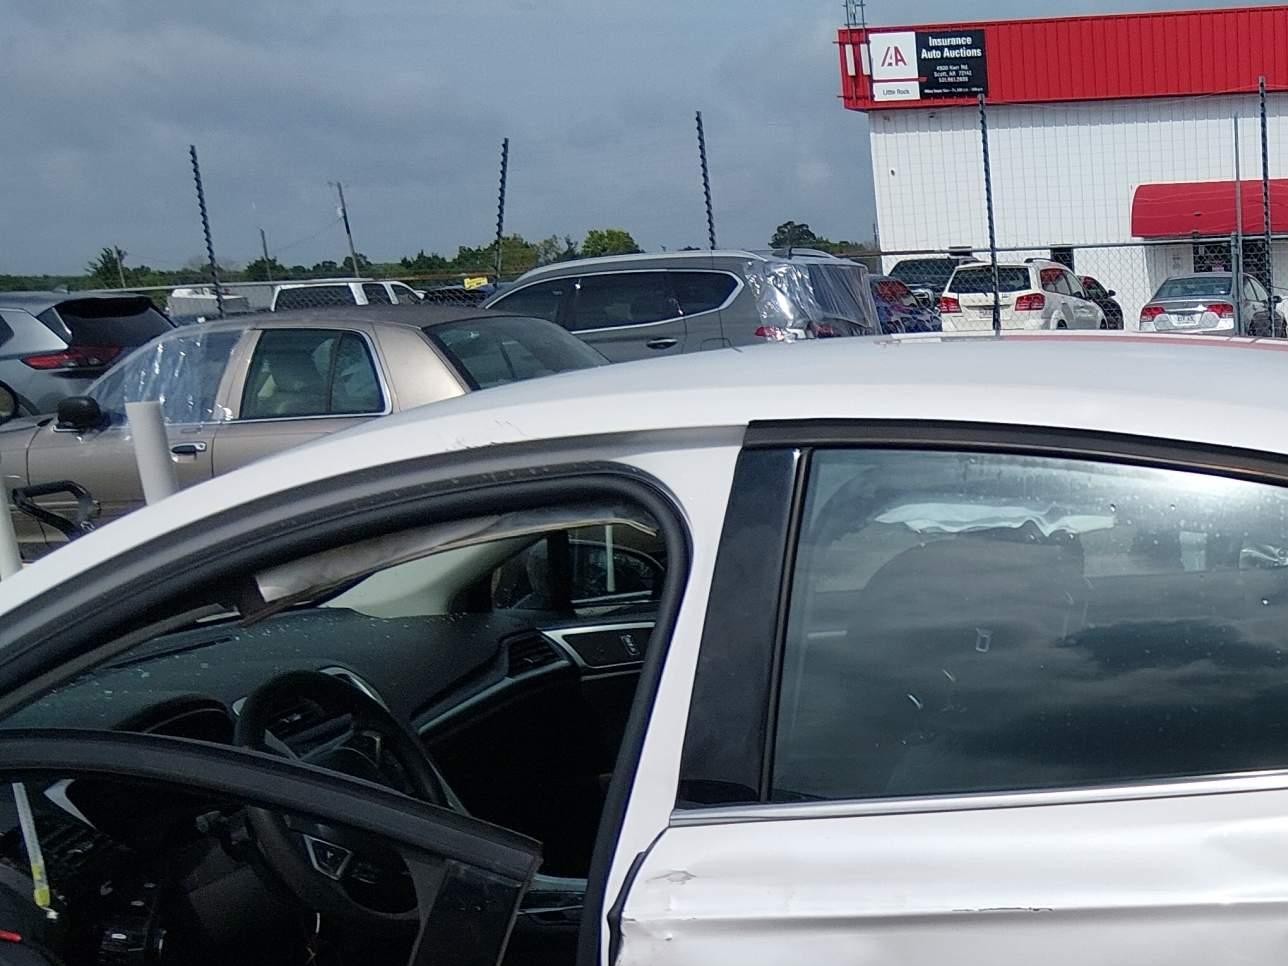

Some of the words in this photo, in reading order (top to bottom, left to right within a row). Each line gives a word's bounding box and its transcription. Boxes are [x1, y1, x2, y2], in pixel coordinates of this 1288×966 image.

[928, 35, 972, 46] Insurance
[921, 49, 941, 59] Auto
[943, 47, 982, 59] Auctions
